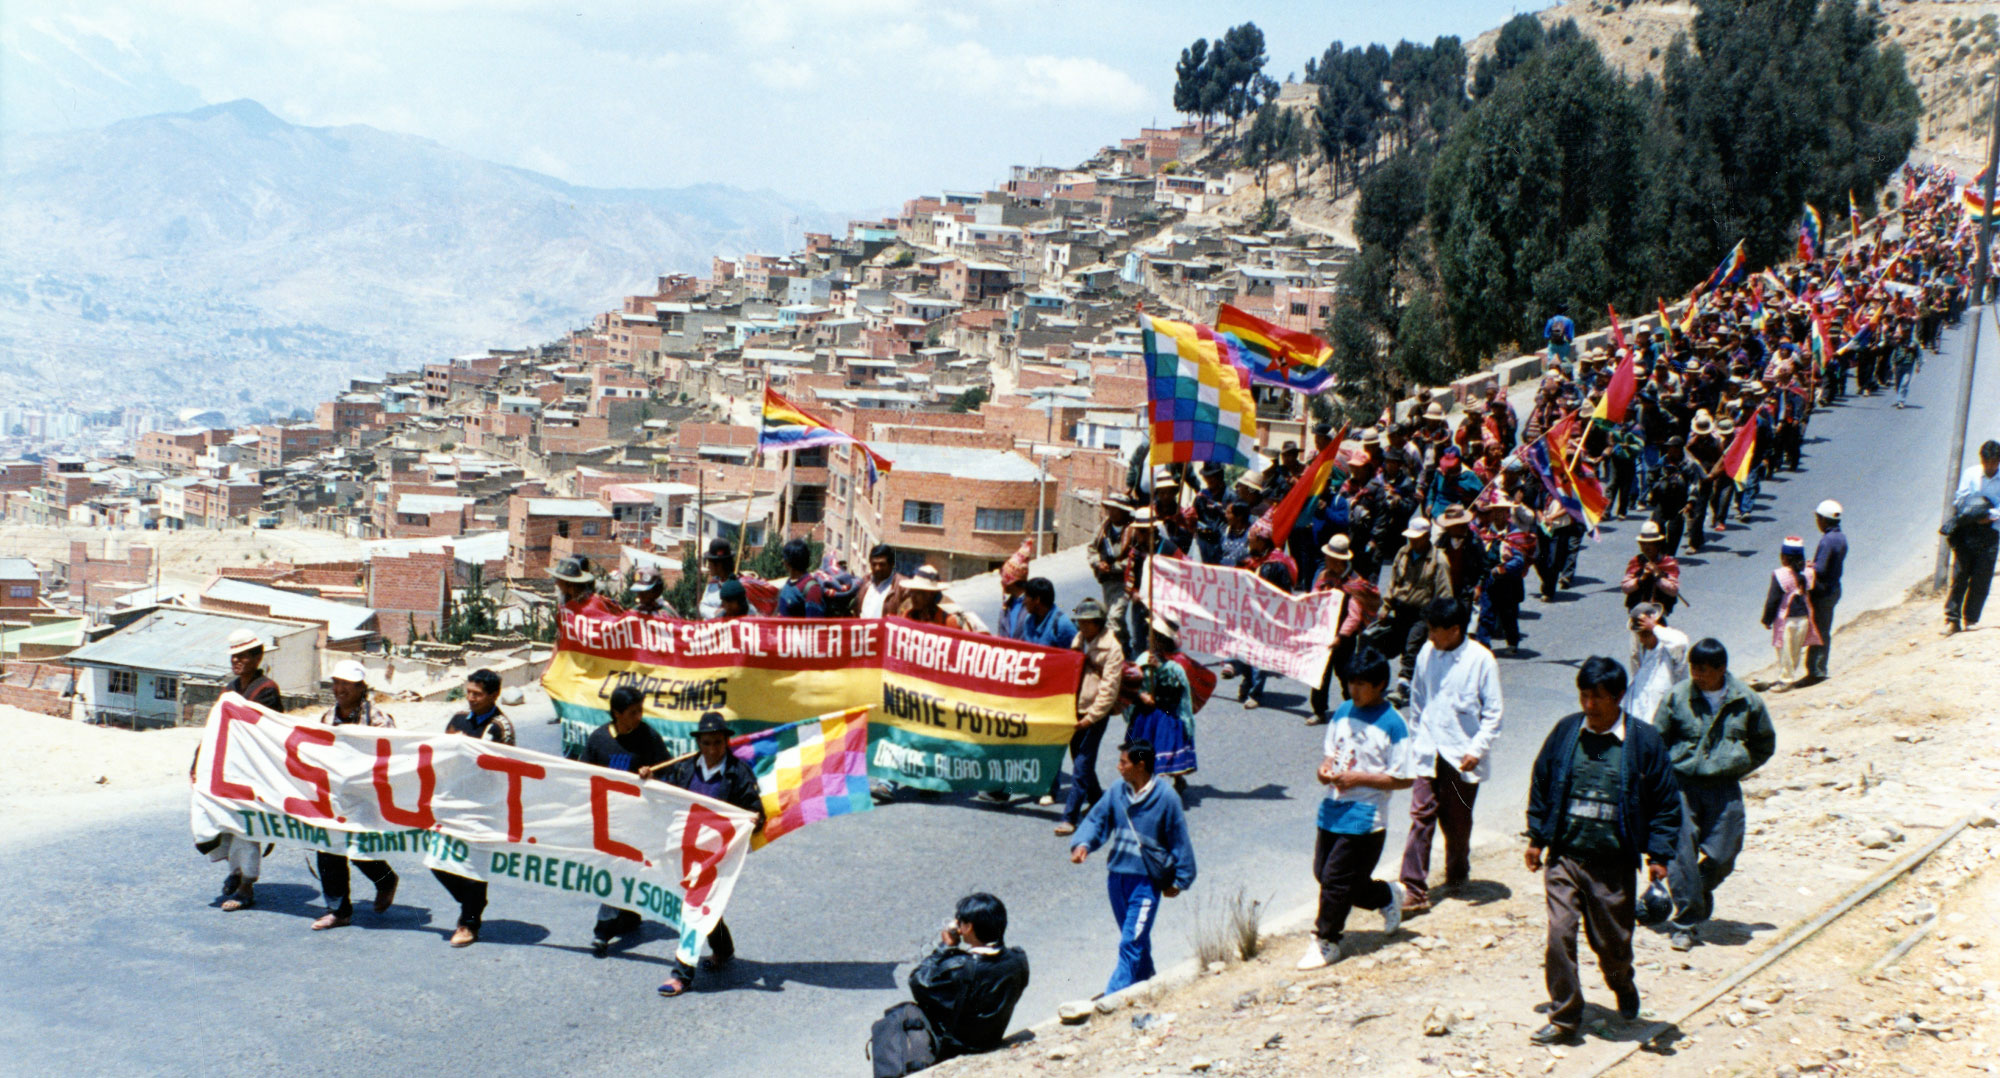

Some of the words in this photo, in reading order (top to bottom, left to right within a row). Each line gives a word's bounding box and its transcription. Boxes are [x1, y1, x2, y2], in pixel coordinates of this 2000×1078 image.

[681, 620, 768, 657] SINDICAL
[777, 624, 842, 658] UNICA
[850, 623, 878, 657] DE
[885, 622, 1046, 685] TRABAJADORES
[883, 682, 946, 727] NORTE
[988, 758, 1040, 783] ALONSO
[490, 851, 612, 897] DERECHO
